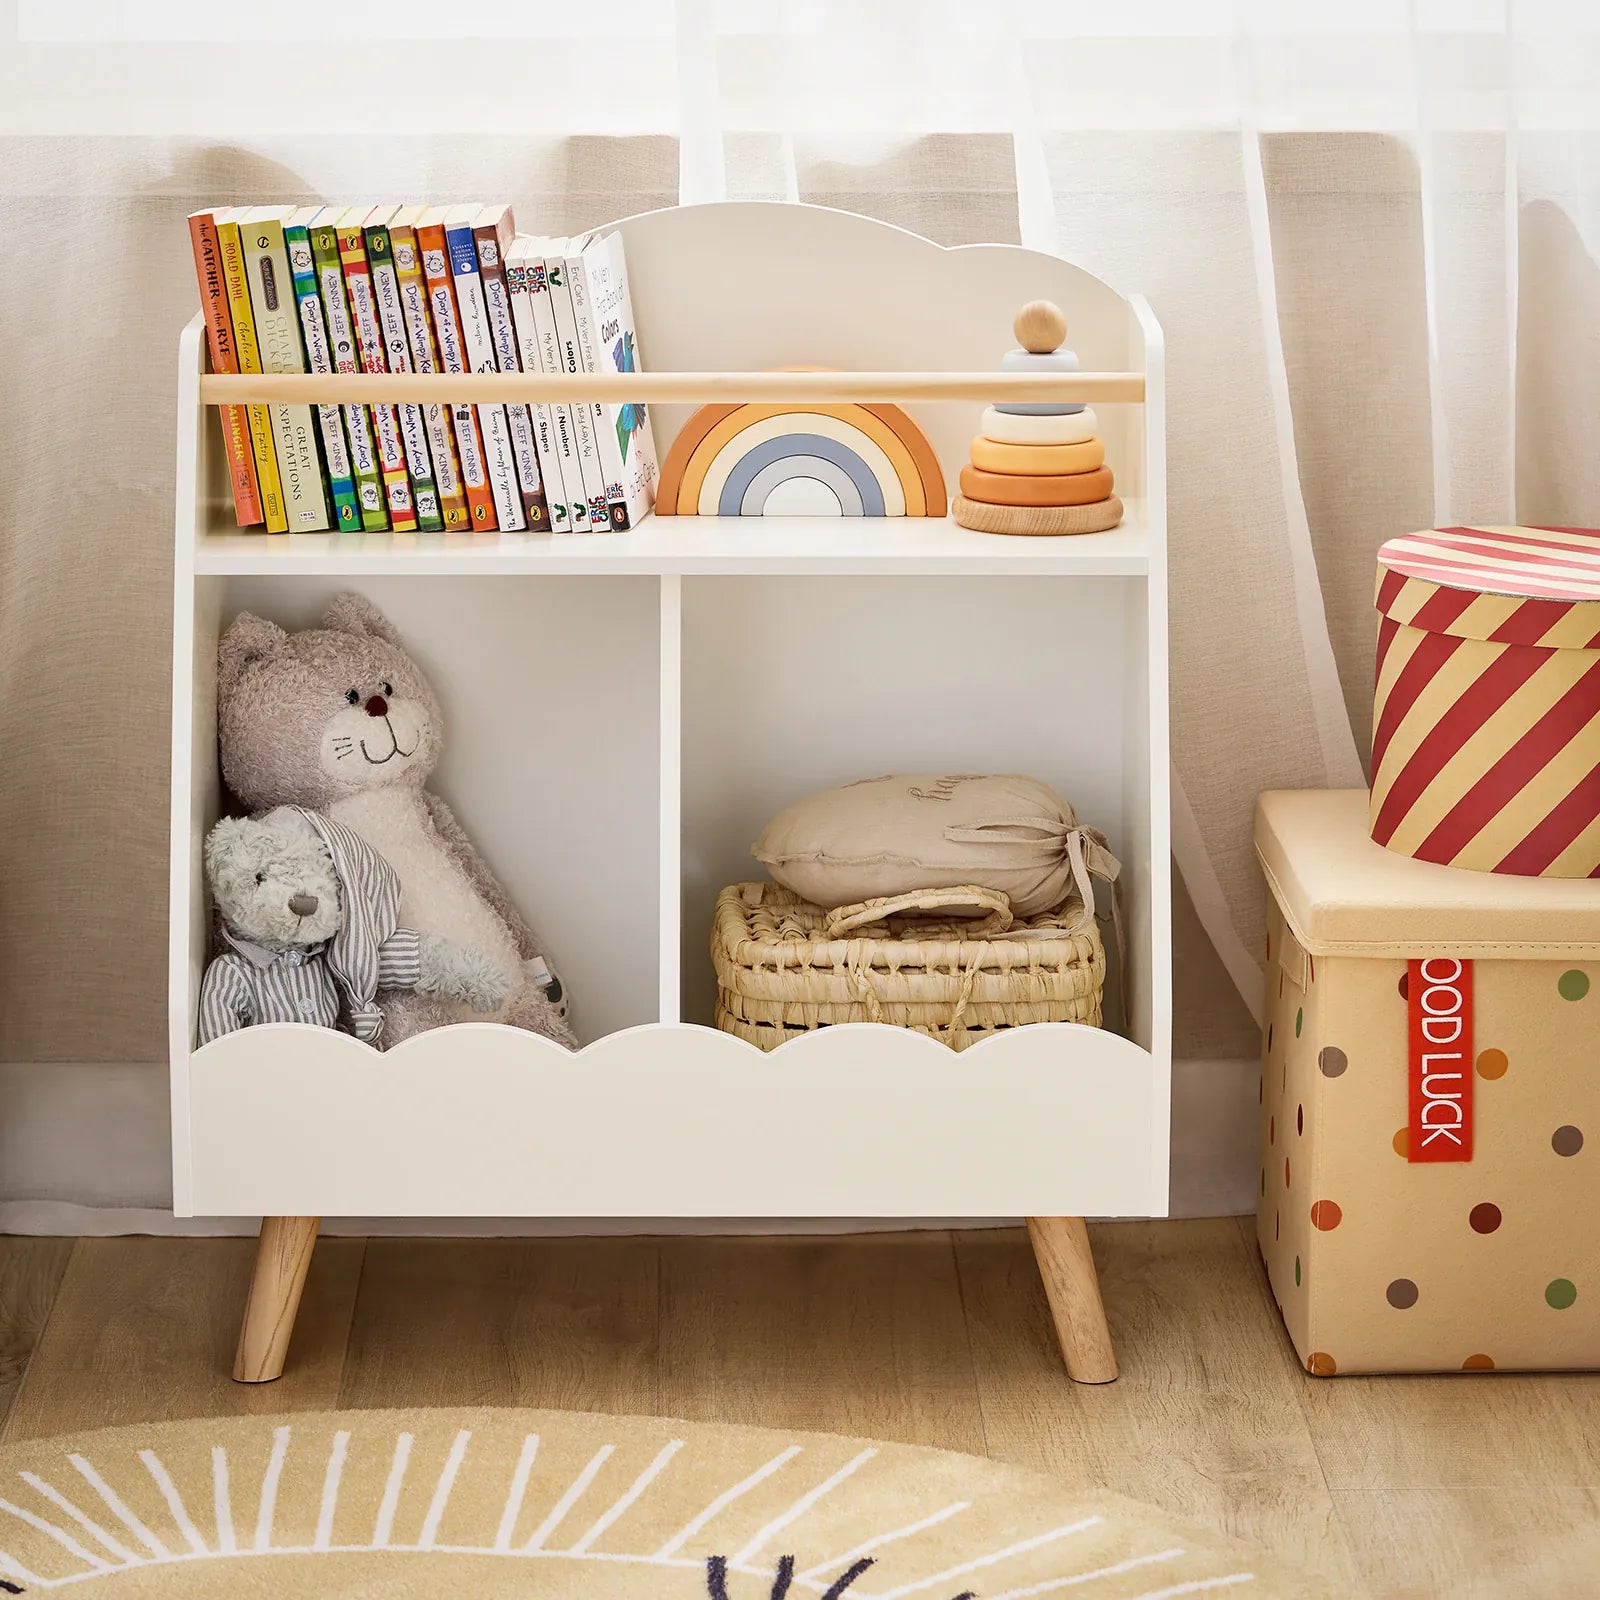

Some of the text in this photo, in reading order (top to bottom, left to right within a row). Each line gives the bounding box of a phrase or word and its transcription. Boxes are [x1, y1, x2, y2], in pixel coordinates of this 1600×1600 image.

[200, 223, 208, 238] the
[202, 238, 220, 300] CATCHER
[224, 242, 243, 302] ROALD DAHL
[507, 268, 519, 295] CARLE
[515, 266, 528, 293] ERIC
[526, 267, 540, 294] CARLE
[535, 266, 548, 292] ERIC
[571, 266, 580, 282] Eric
[328, 274, 345, 336] JEFF KINNEY
[356, 280, 372, 337] JEFF KINNEY
[380, 272, 398, 336] JEFF KINNEY
[436, 290, 448, 316] Diary
[574, 284, 584, 306] Carle
[213, 312, 225, 328] the
[406, 284, 420, 312] Diary
[414, 328, 426, 358] Wimpy
[420, 360, 432, 374] Kid
[489, 282, 502, 308] Diary
[498, 325, 509, 355] Wimpy
[504, 356, 514, 370] Kid
[601, 318, 620, 344] Colors
[216, 327, 230, 358] RYE
[277, 316, 294, 374] CHARL
[305, 300, 316, 324] Diary
[312, 338, 324, 364] Wimpy
[318, 365, 327, 374] Ki
[444, 332, 456, 363] Wimpy
[544, 332, 551, 346] My
[546, 346, 555, 364] Very
[566, 340, 576, 373] Colors
[449, 364, 460, 374] Ki
[238, 322, 252, 356] Charlie
[256, 432, 268, 462] Factory
[528, 352, 536, 372] Very
[540, 422, 550, 454] Shapes
[352, 404, 361, 428] Wimp
[380, 404, 389, 422] Wim
[406, 404, 416, 433] Wimpy
[492, 409, 502, 435] Being
[556, 406, 566, 414] of
[577, 406, 585, 424] First
[296, 426, 311, 470] GREAT
[329, 420, 344, 475] JEFF KINNEY
[559, 416, 570, 458] Numbers
[581, 425, 589, 445] Very
[357, 443, 370, 470] Diary
[385, 438, 398, 462] Diary
[412, 449, 426, 476] Diary
[434, 427, 452, 490] JEFF KINNEY
[462, 422, 478, 484] JEFF KINNEY
[516, 423, 534, 487] JEFF KINNEY
[584, 446, 592, 458] My
[606, 483, 624, 494] ERIC
[607, 492, 624, 500] CARLE
[588, 498, 600, 524] ERIC
[598, 495, 609, 523] CARLE
[507, 518, 516, 528] The
[1420, 959, 1463, 1148] OOD LUCK
